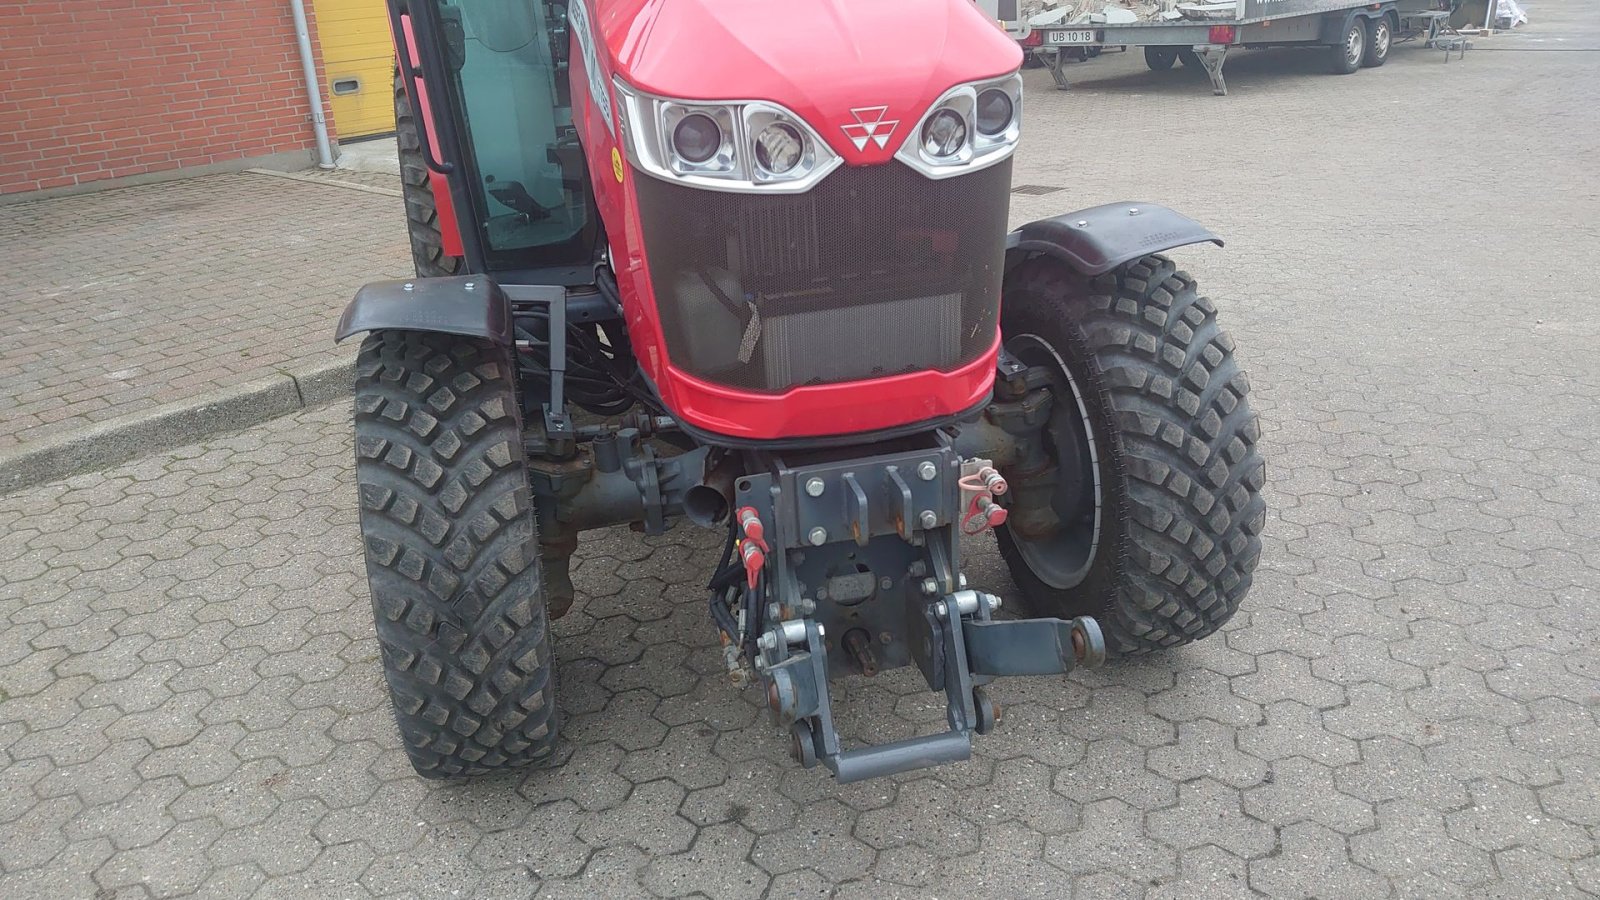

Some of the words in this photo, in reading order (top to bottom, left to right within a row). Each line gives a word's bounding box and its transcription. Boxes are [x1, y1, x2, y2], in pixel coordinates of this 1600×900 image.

[1052, 32, 1065, 42] UB
[1068, 32, 1078, 42] 10
[1081, 31, 1091, 41] 18
